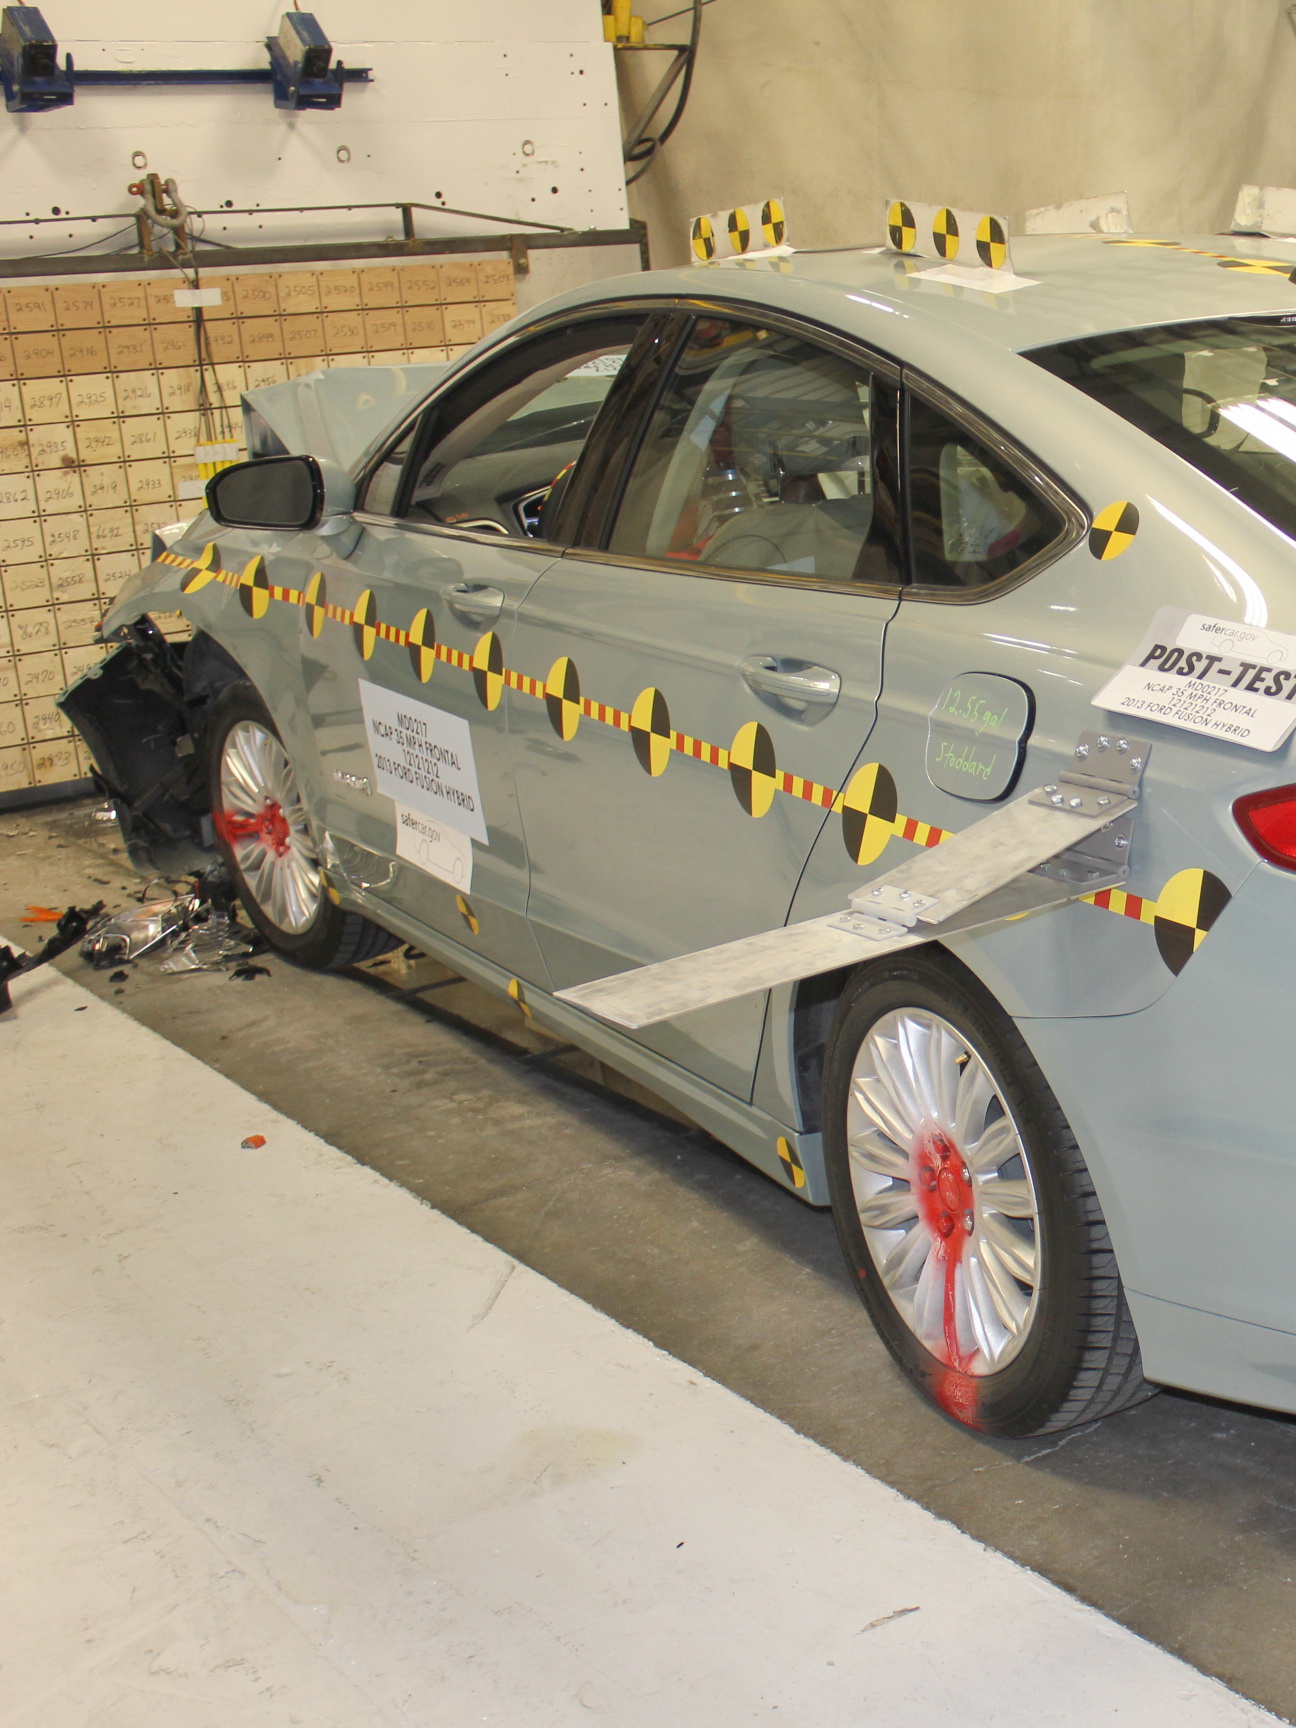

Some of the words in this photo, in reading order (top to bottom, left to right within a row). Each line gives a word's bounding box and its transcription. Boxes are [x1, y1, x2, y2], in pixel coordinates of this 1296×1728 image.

[1199, 621, 1260, 643] safercar.gov
[1120, 696, 1146, 710] 2013
[1144, 701, 1173, 716] FORD
[1172, 708, 1213, 728] FUSION
[1210, 719, 1252, 739] HYBRID
[1142, 681, 1174, 694] NCAP
[1171, 687, 1186, 698] 35
[1186, 691, 1212, 705] MPH
[1210, 697, 1259, 720] FRONTAL
[372, 718, 394, 741] NCAP
[394, 727, 405, 747] 35
[424, 739, 462, 772] FRONTAL
[392, 760, 414, 785] FORD
[413, 769, 445, 799] FUSION
[444, 783, 476, 813] HYBRID
